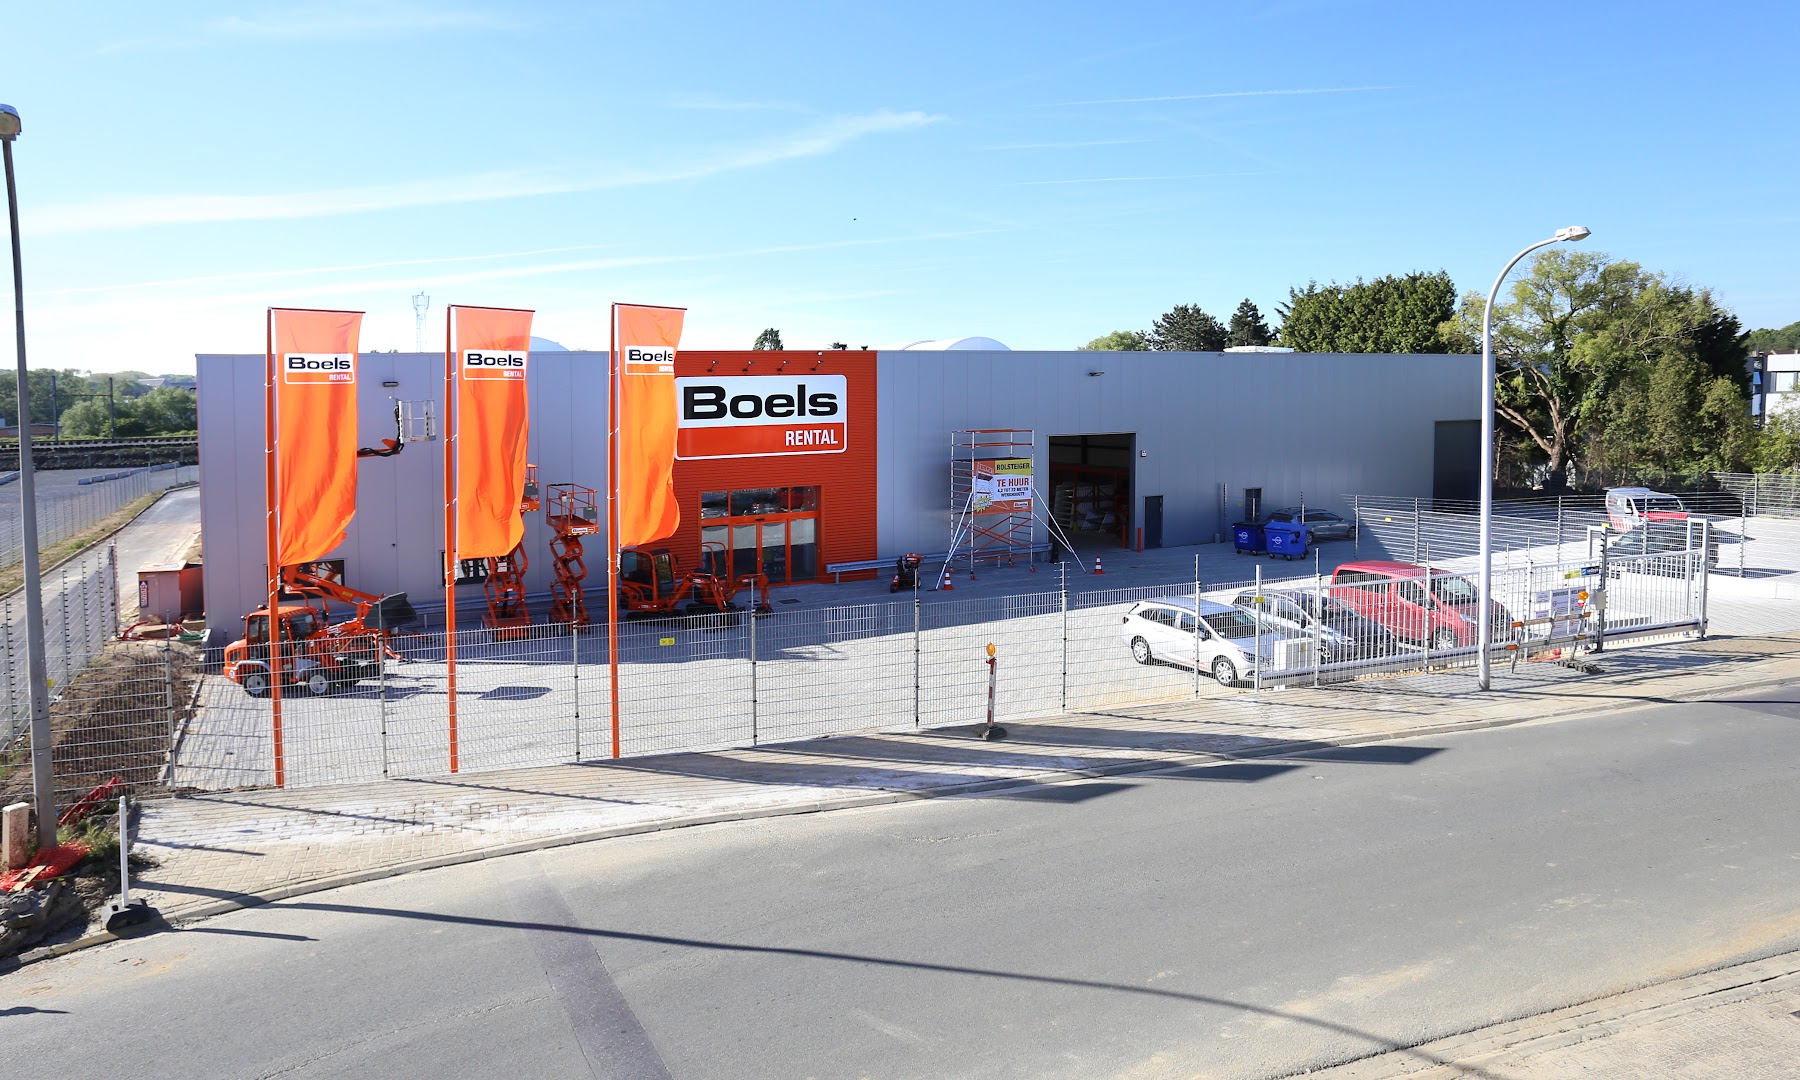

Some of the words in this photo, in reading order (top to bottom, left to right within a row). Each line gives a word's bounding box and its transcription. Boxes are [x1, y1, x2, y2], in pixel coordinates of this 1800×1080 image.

[288, 357, 351, 369] Boels
[467, 353, 523, 366] Boels
[329, 373, 351, 381] RENTAL
[683, 384, 838, 420] Boels
[785, 429, 838, 446] RENTAL
[997, 479, 1006, 487] TE
[1008, 478, 1029, 486] HUUR
